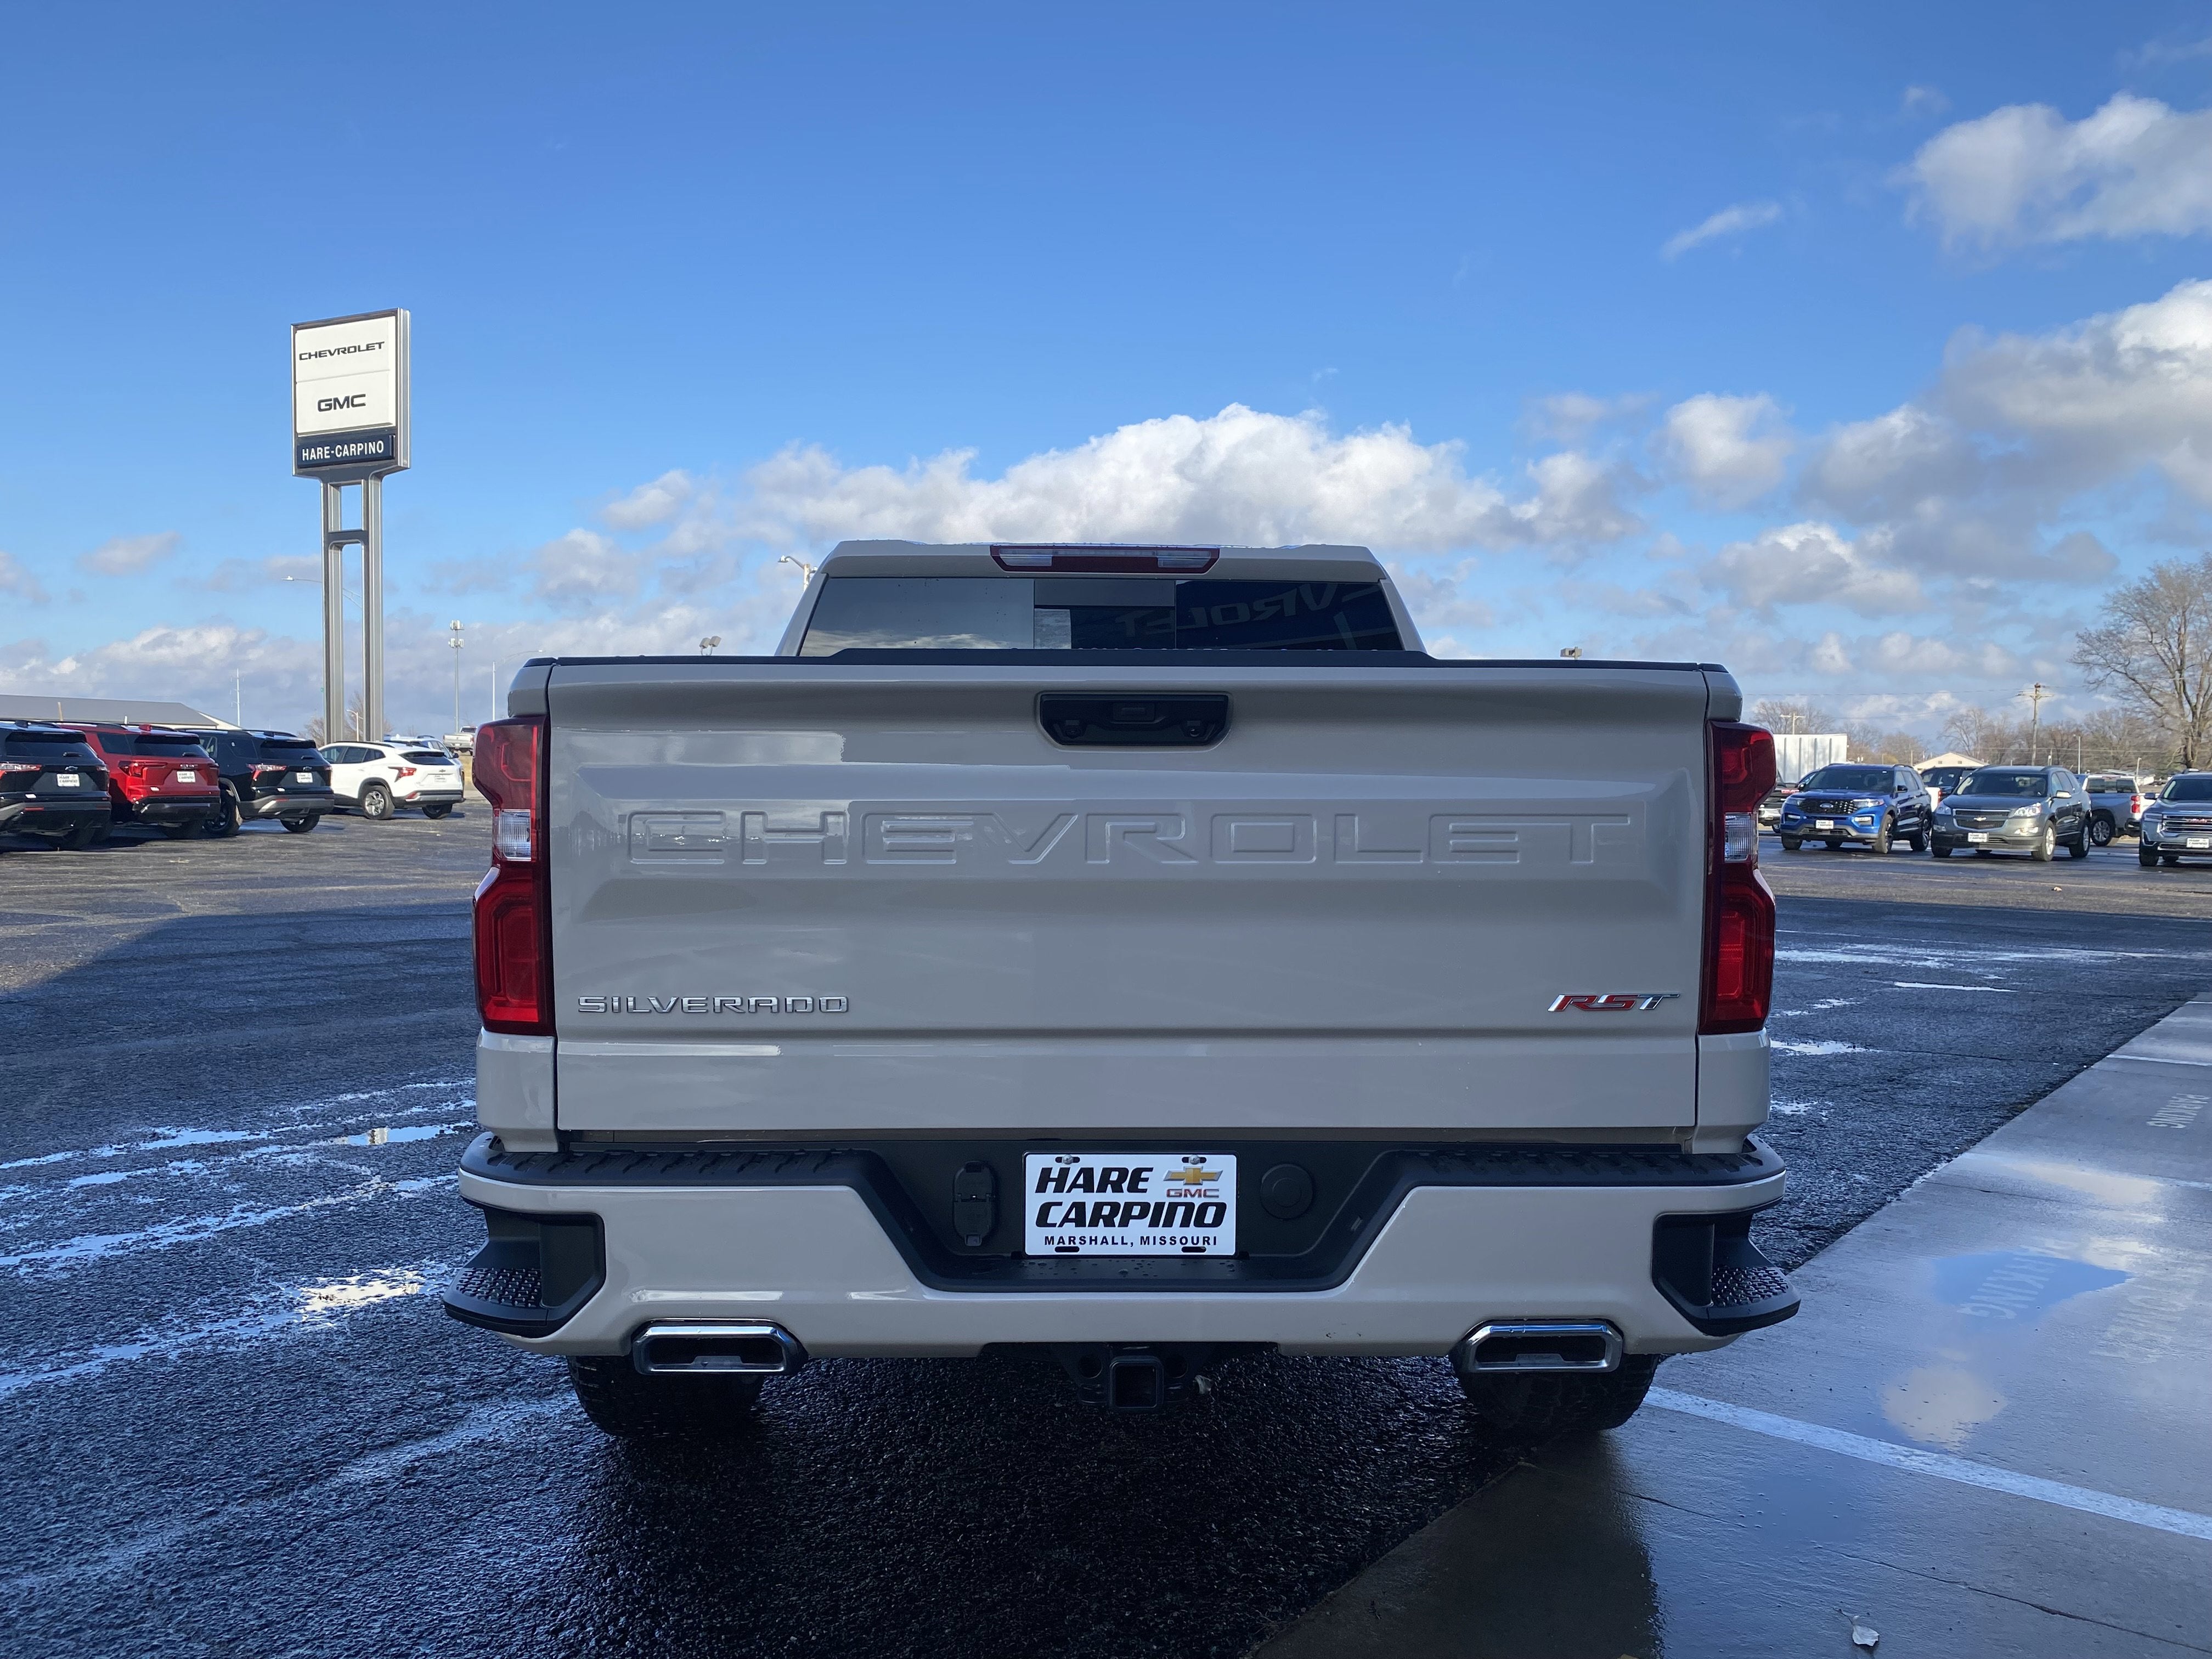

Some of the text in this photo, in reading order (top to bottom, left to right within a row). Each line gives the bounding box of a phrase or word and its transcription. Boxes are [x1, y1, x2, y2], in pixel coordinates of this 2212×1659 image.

[298, 341, 385, 360] CHEVROLET
[317, 393, 366, 412] GMC
[302, 440, 384, 461] HARE-CARPINO
[628, 810, 1631, 865] CHEVROLET
[578, 996, 849, 1013] SILVERADO
[1547, 994, 1681, 1012] RST
[2146, 1093, 2211, 1128] PARKING
[1035, 1167, 1154, 1193] HARE
[1166, 1188, 1220, 1198] GMC
[1035, 1201, 1227, 1228] CARPINO
[1044, 1235, 1217, 1247] MARSHALL, MISSOURI
[1956, 1236, 2078, 1319] PARKING
